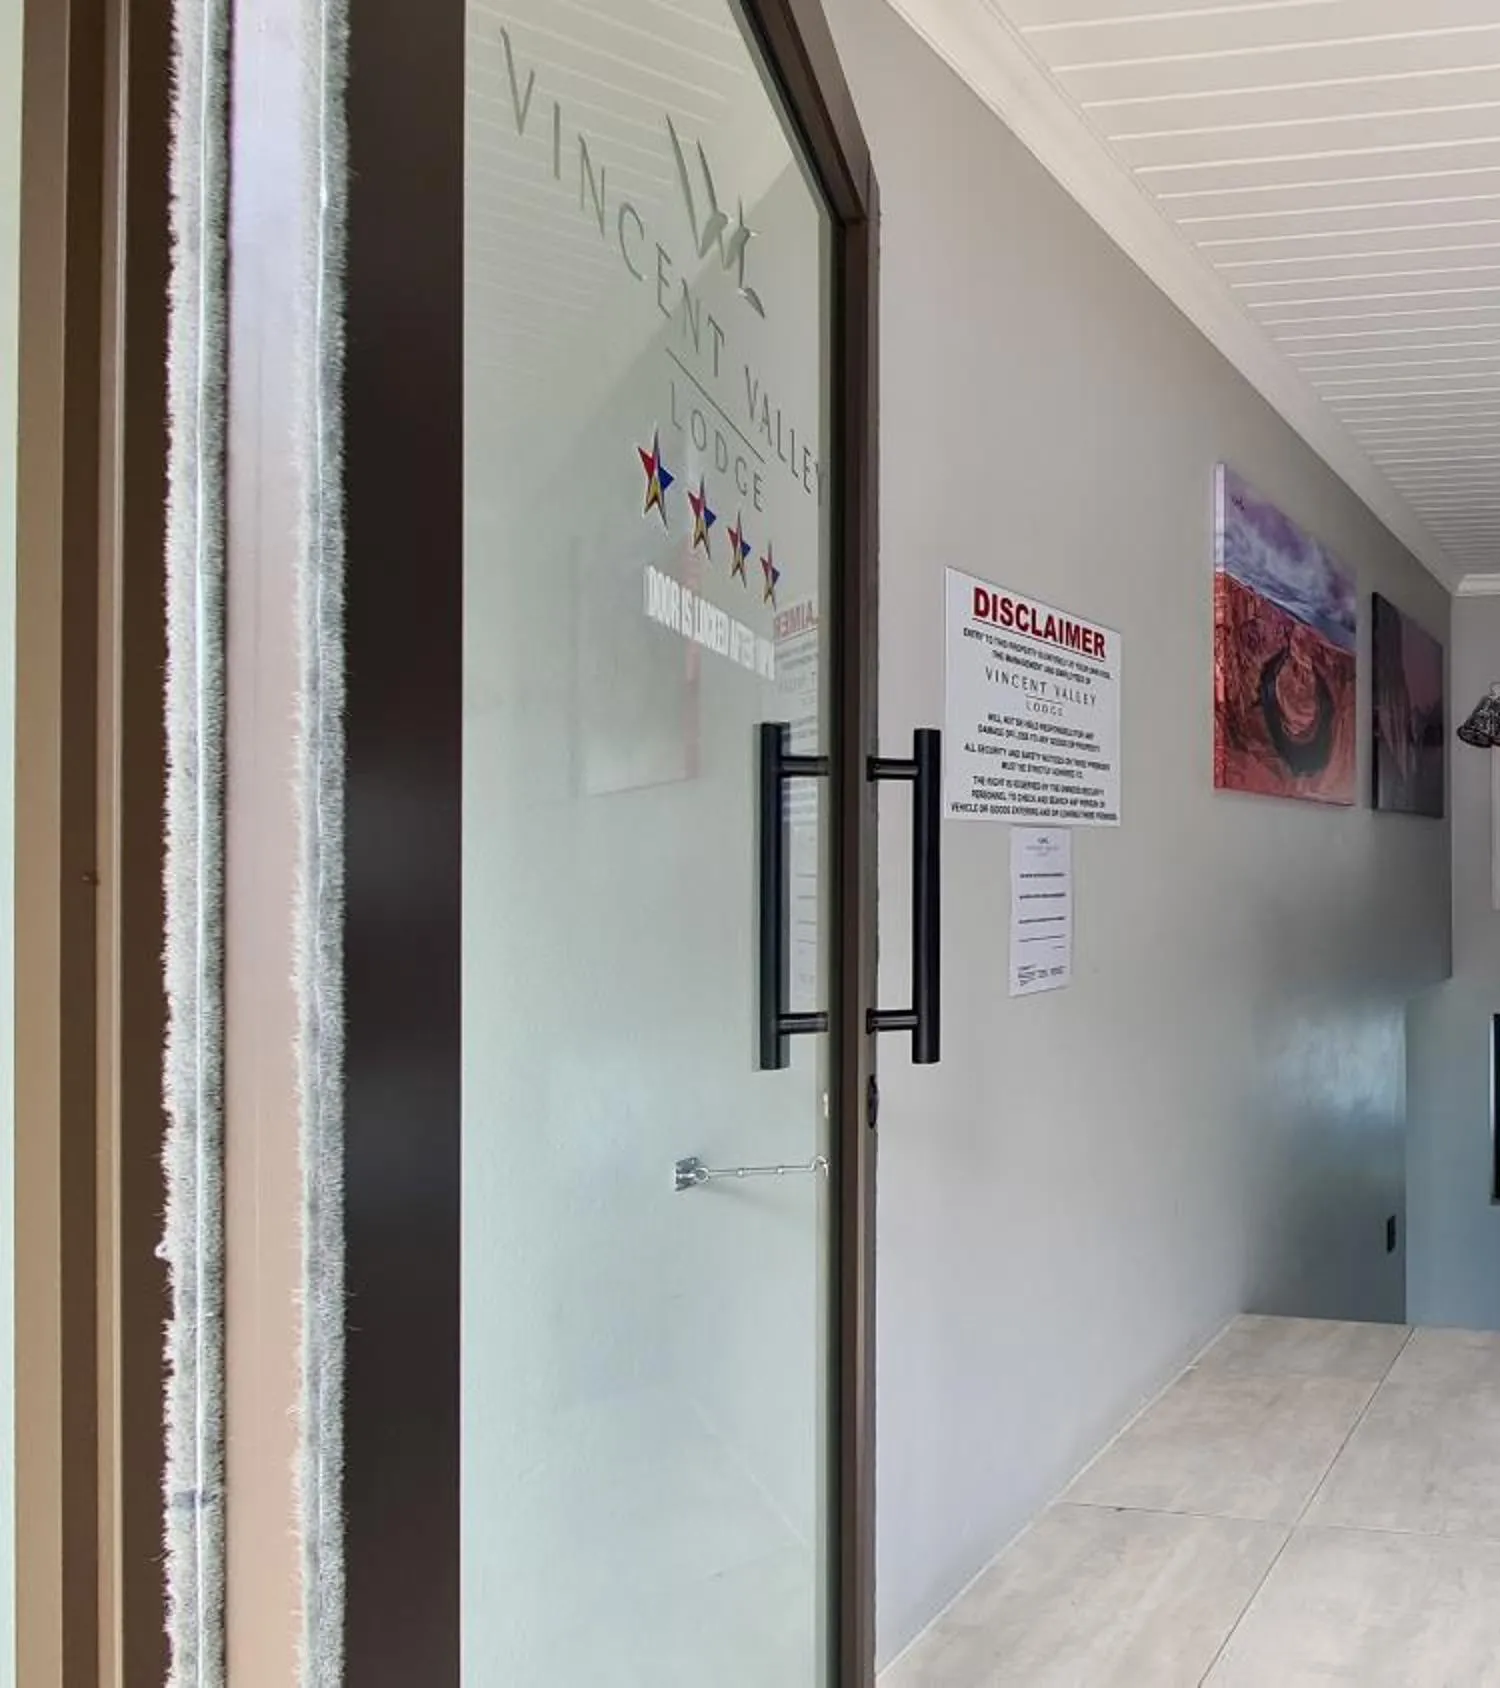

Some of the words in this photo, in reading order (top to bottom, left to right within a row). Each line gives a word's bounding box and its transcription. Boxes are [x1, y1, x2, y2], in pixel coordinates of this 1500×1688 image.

[500, 26, 725, 378] VINCENT
[670, 381, 765, 512] LODGE
[974, 586, 1106, 658] DISCLAIMER
[985, 665, 1046, 695] VINCENT
[1054, 683, 1096, 707] VALLEY
[1026, 701, 1062, 717] LODGE
